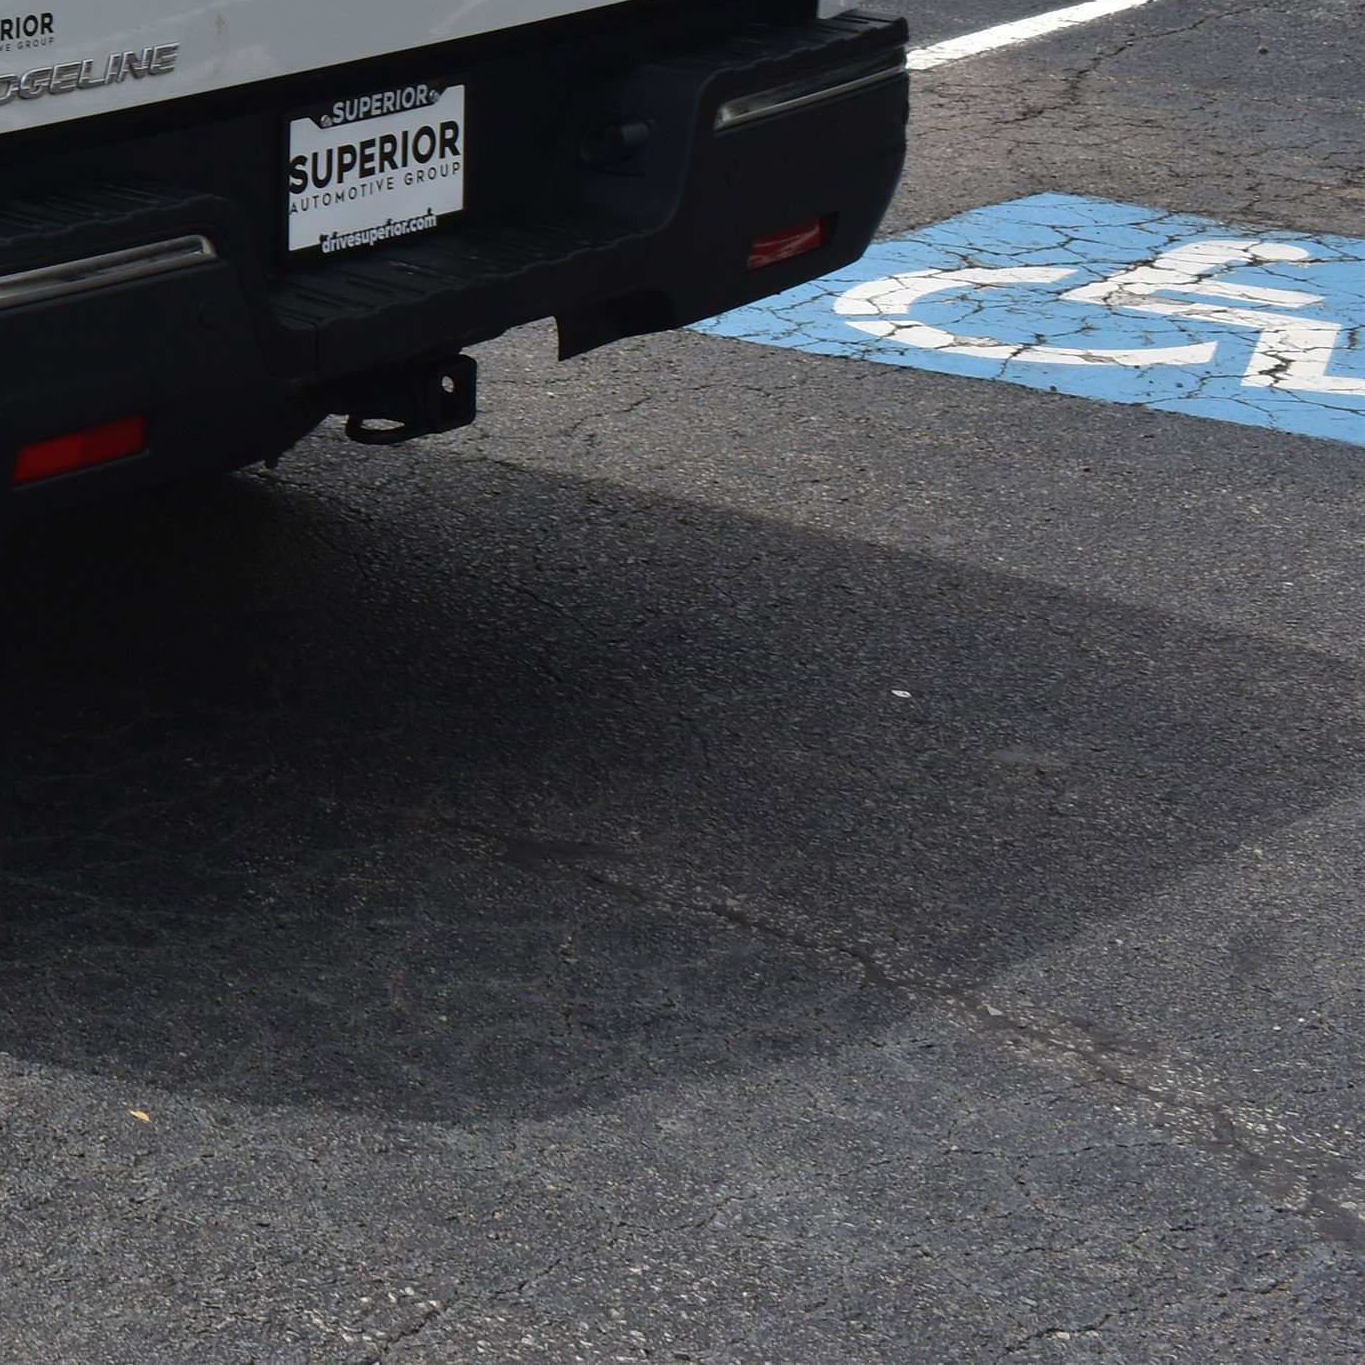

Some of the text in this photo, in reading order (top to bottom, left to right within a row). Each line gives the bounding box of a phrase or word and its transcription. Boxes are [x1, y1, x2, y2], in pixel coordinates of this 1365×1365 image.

[17, 36, 55, 51] GROUP
[332, 84, 428, 125] SUPERIOR
[289, 120, 461, 195] SUPERIOR
[289, 161, 461, 215] AUTOMOTIVE GROUP
[321, 212, 437, 253] drivesuperior.com
